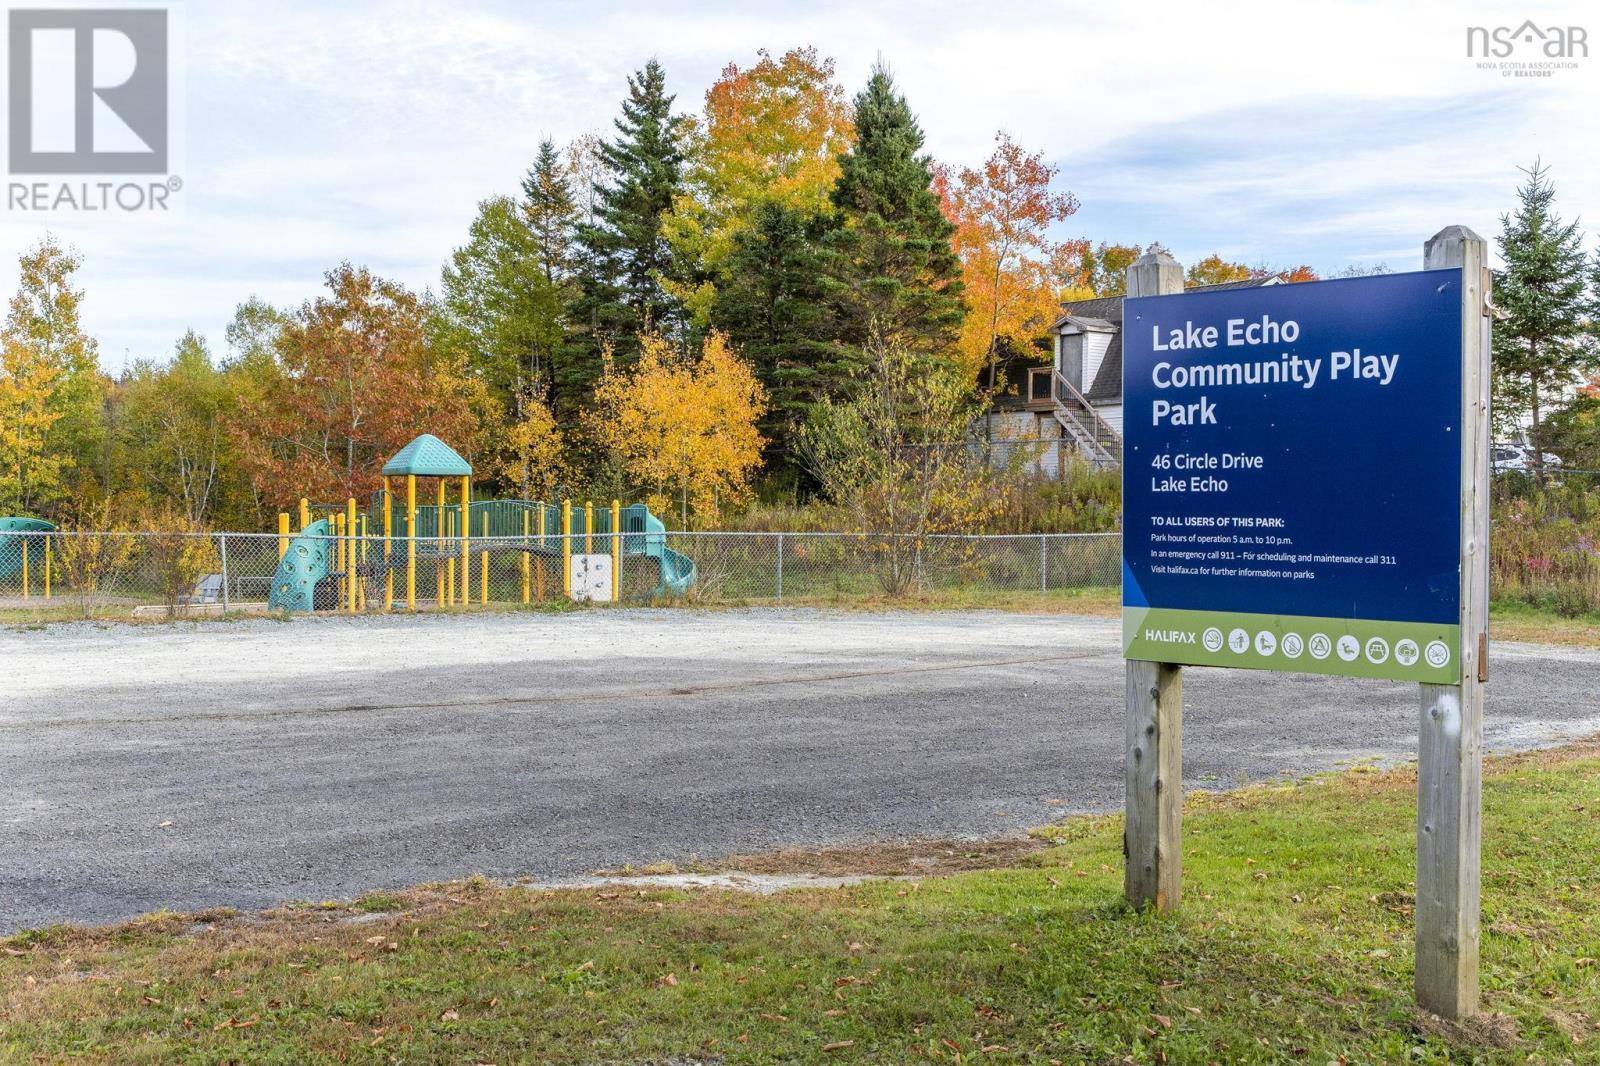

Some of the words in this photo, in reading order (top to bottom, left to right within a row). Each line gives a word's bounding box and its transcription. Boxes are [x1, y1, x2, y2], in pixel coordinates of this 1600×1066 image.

[1152, 320, 1218, 351] Lake
[1227, 315, 1300, 346] Echo
[1152, 353, 1321, 388] Community
[1331, 349, 1399, 385] Play
[1152, 396, 1218, 427] Park
[1151, 454, 1171, 470] 46
[1174, 453, 1218, 469] Circle
[1221, 452, 1264, 469] Drive
[1151, 476, 1187, 493] Lake
[1190, 475, 1229, 492] Echo
[1151, 516, 1165, 526] TO
[1166, 517, 1183, 526] ALL
[1185, 517, 1215, 527] USERS
[1216, 517, 1230, 527] OF
[1232, 517, 1254, 527] THIS
[1256, 518, 1285, 528] PARK:
[1151, 533, 1167, 542] Park
[1167, 534, 1187, 542] hours
[1188, 534, 1197, 542] of
[1197, 535, 1232, 544] operation
[1232, 535, 1238, 543] 5
[1239, 536, 1254, 544] a.m.
[1255, 536, 1264, 544] to
[1265, 536, 1276, 544] 10
[1276, 537, 1293, 546] p.m.
[1151, 549, 1158, 558] In
[1158, 550, 1167, 558] an
[1168, 551, 1205, 560] emergency
[1207, 550, 1220, 559] call
[1220, 551, 1235, 560] 911
[1243, 551, 1255, 560] For
[1256, 552, 1297, 563] scheduling
[1297, 553, 1312, 562] and
[1313, 553, 1363, 563] maintenance
[1364, 555, 1379, 564] call
[1380, 556, 1397, 565] 311
[1151, 565, 1166, 573] Visit
[1167, 565, 1199, 574] halifax.ca
[1199, 566, 1210, 575] for
[1211, 567, 1236, 576] further
[1238, 568, 1281, 578] information
[1282, 570, 1292, 578] on
[1293, 570, 1315, 580] parks
[1145, 629, 1197, 645] HALIFAX
